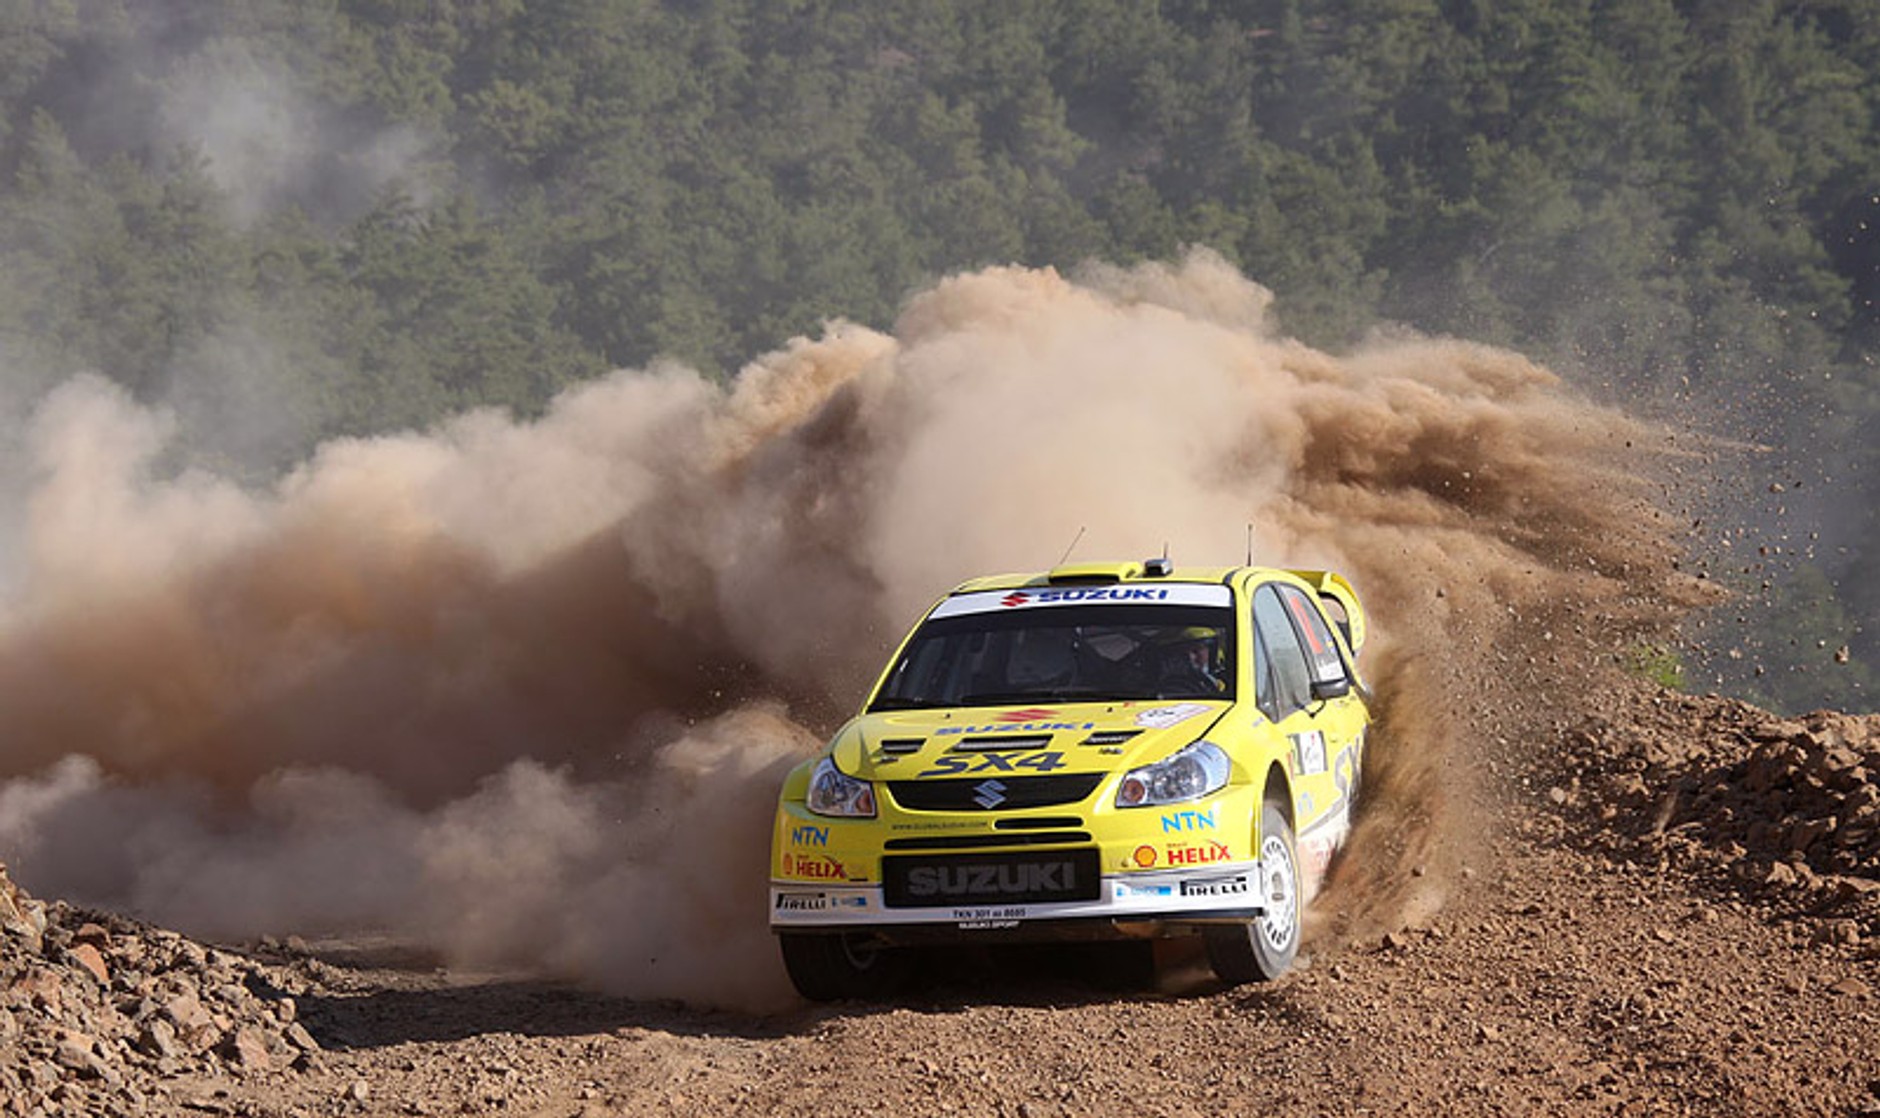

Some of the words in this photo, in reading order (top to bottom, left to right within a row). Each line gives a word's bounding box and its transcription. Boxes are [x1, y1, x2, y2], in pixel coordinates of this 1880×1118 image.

[1038, 589, 1169, 602] SUZUKI
[934, 722, 1096, 736] SUZUKI
[918, 752, 1066, 778] SX4
[1161, 810, 1216, 833] NTN
[792, 827, 830, 846] NTN
[1167, 841, 1232, 866] HELIX
[796, 856, 848, 879] HELIX
[908, 862, 1076, 896] SUZUKI
[1180, 877, 1247, 896] PIRELLI
[776, 892, 826, 909] PIRELLI
